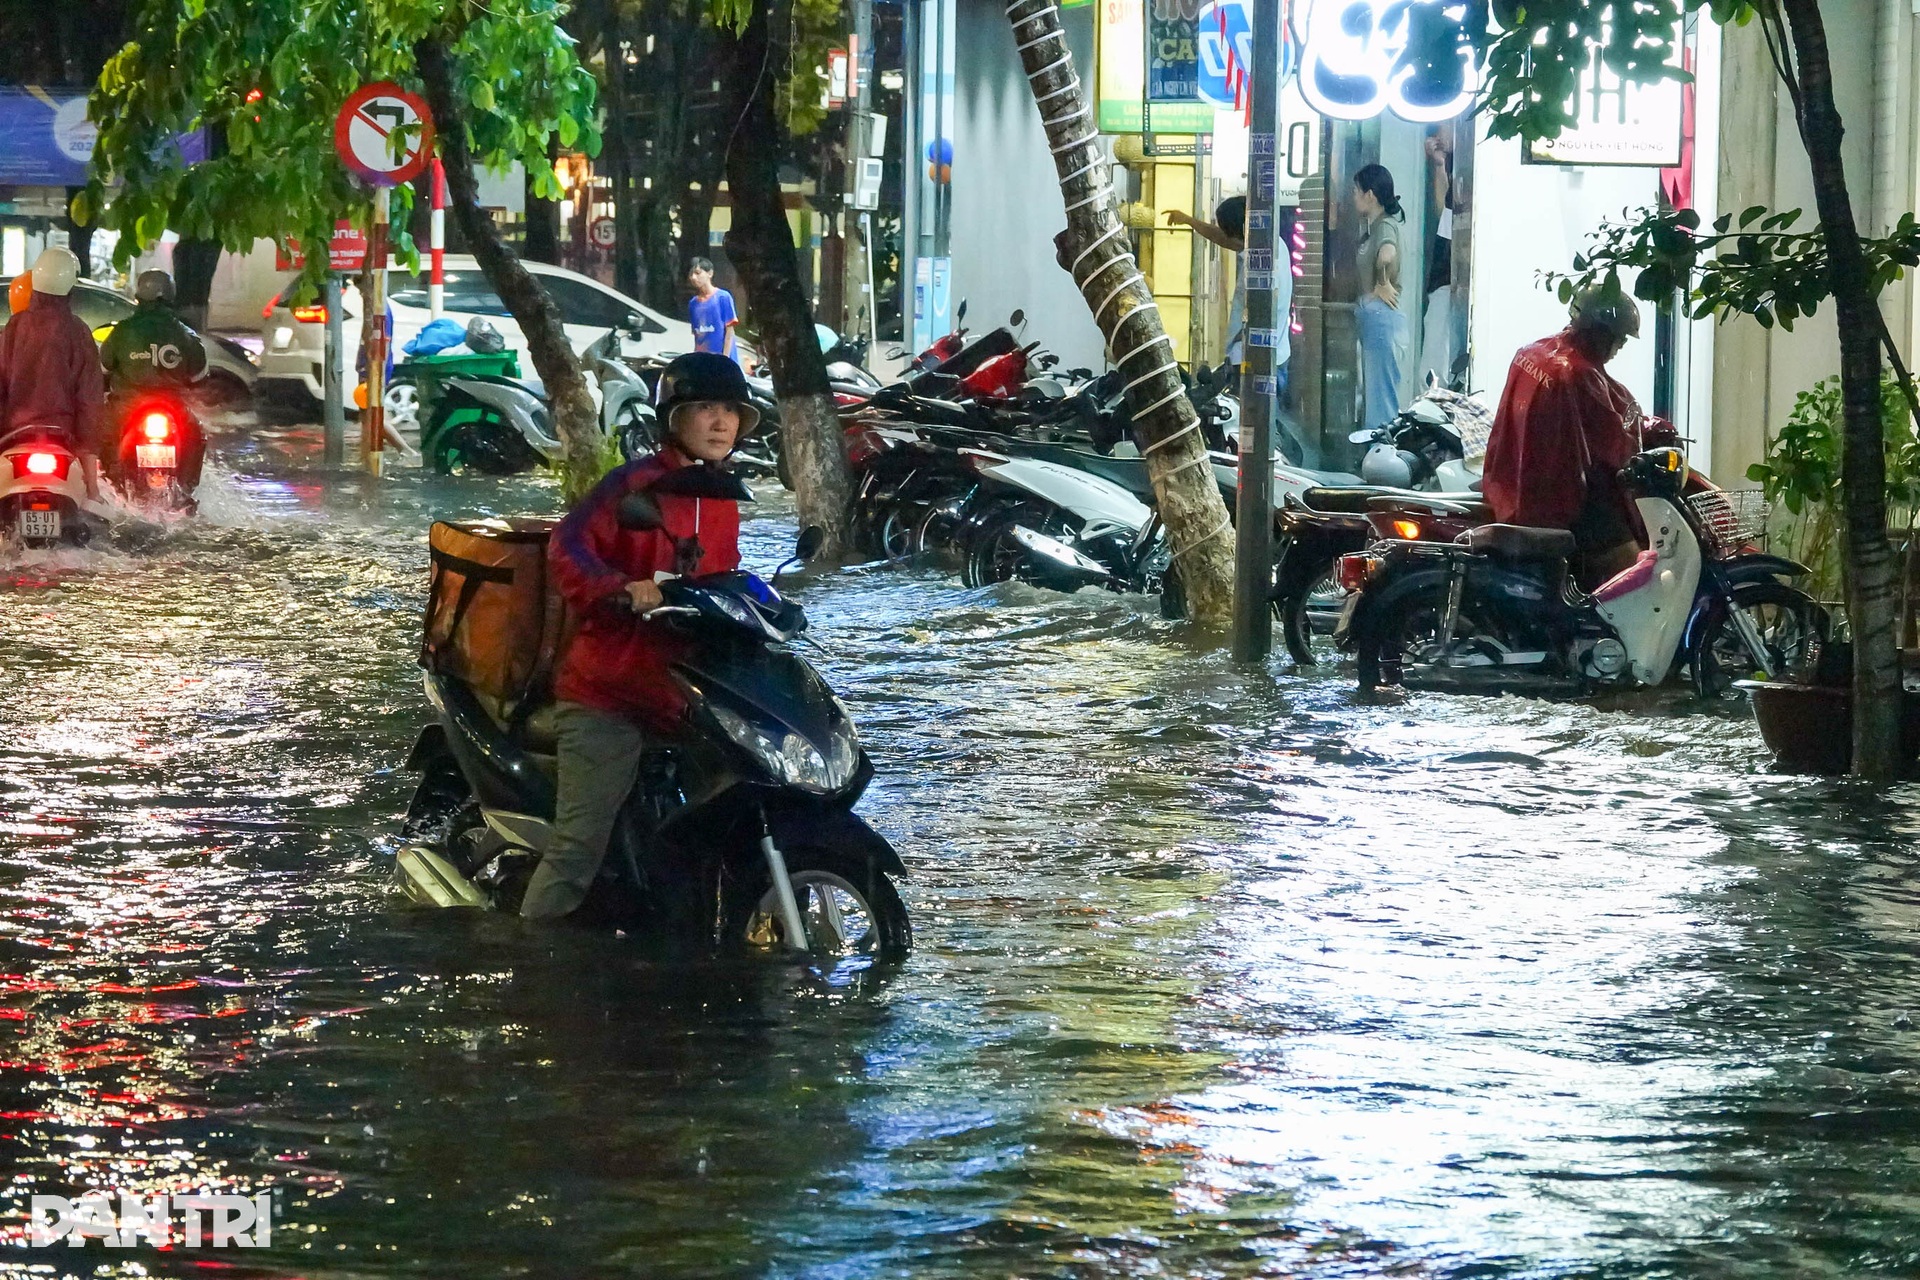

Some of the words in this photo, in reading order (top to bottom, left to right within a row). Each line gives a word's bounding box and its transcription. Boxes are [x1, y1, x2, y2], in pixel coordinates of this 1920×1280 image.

[1159, 39, 1197, 61] CA
[26, 512, 54, 523] 65-U1
[26, 524, 55, 536] 9537
